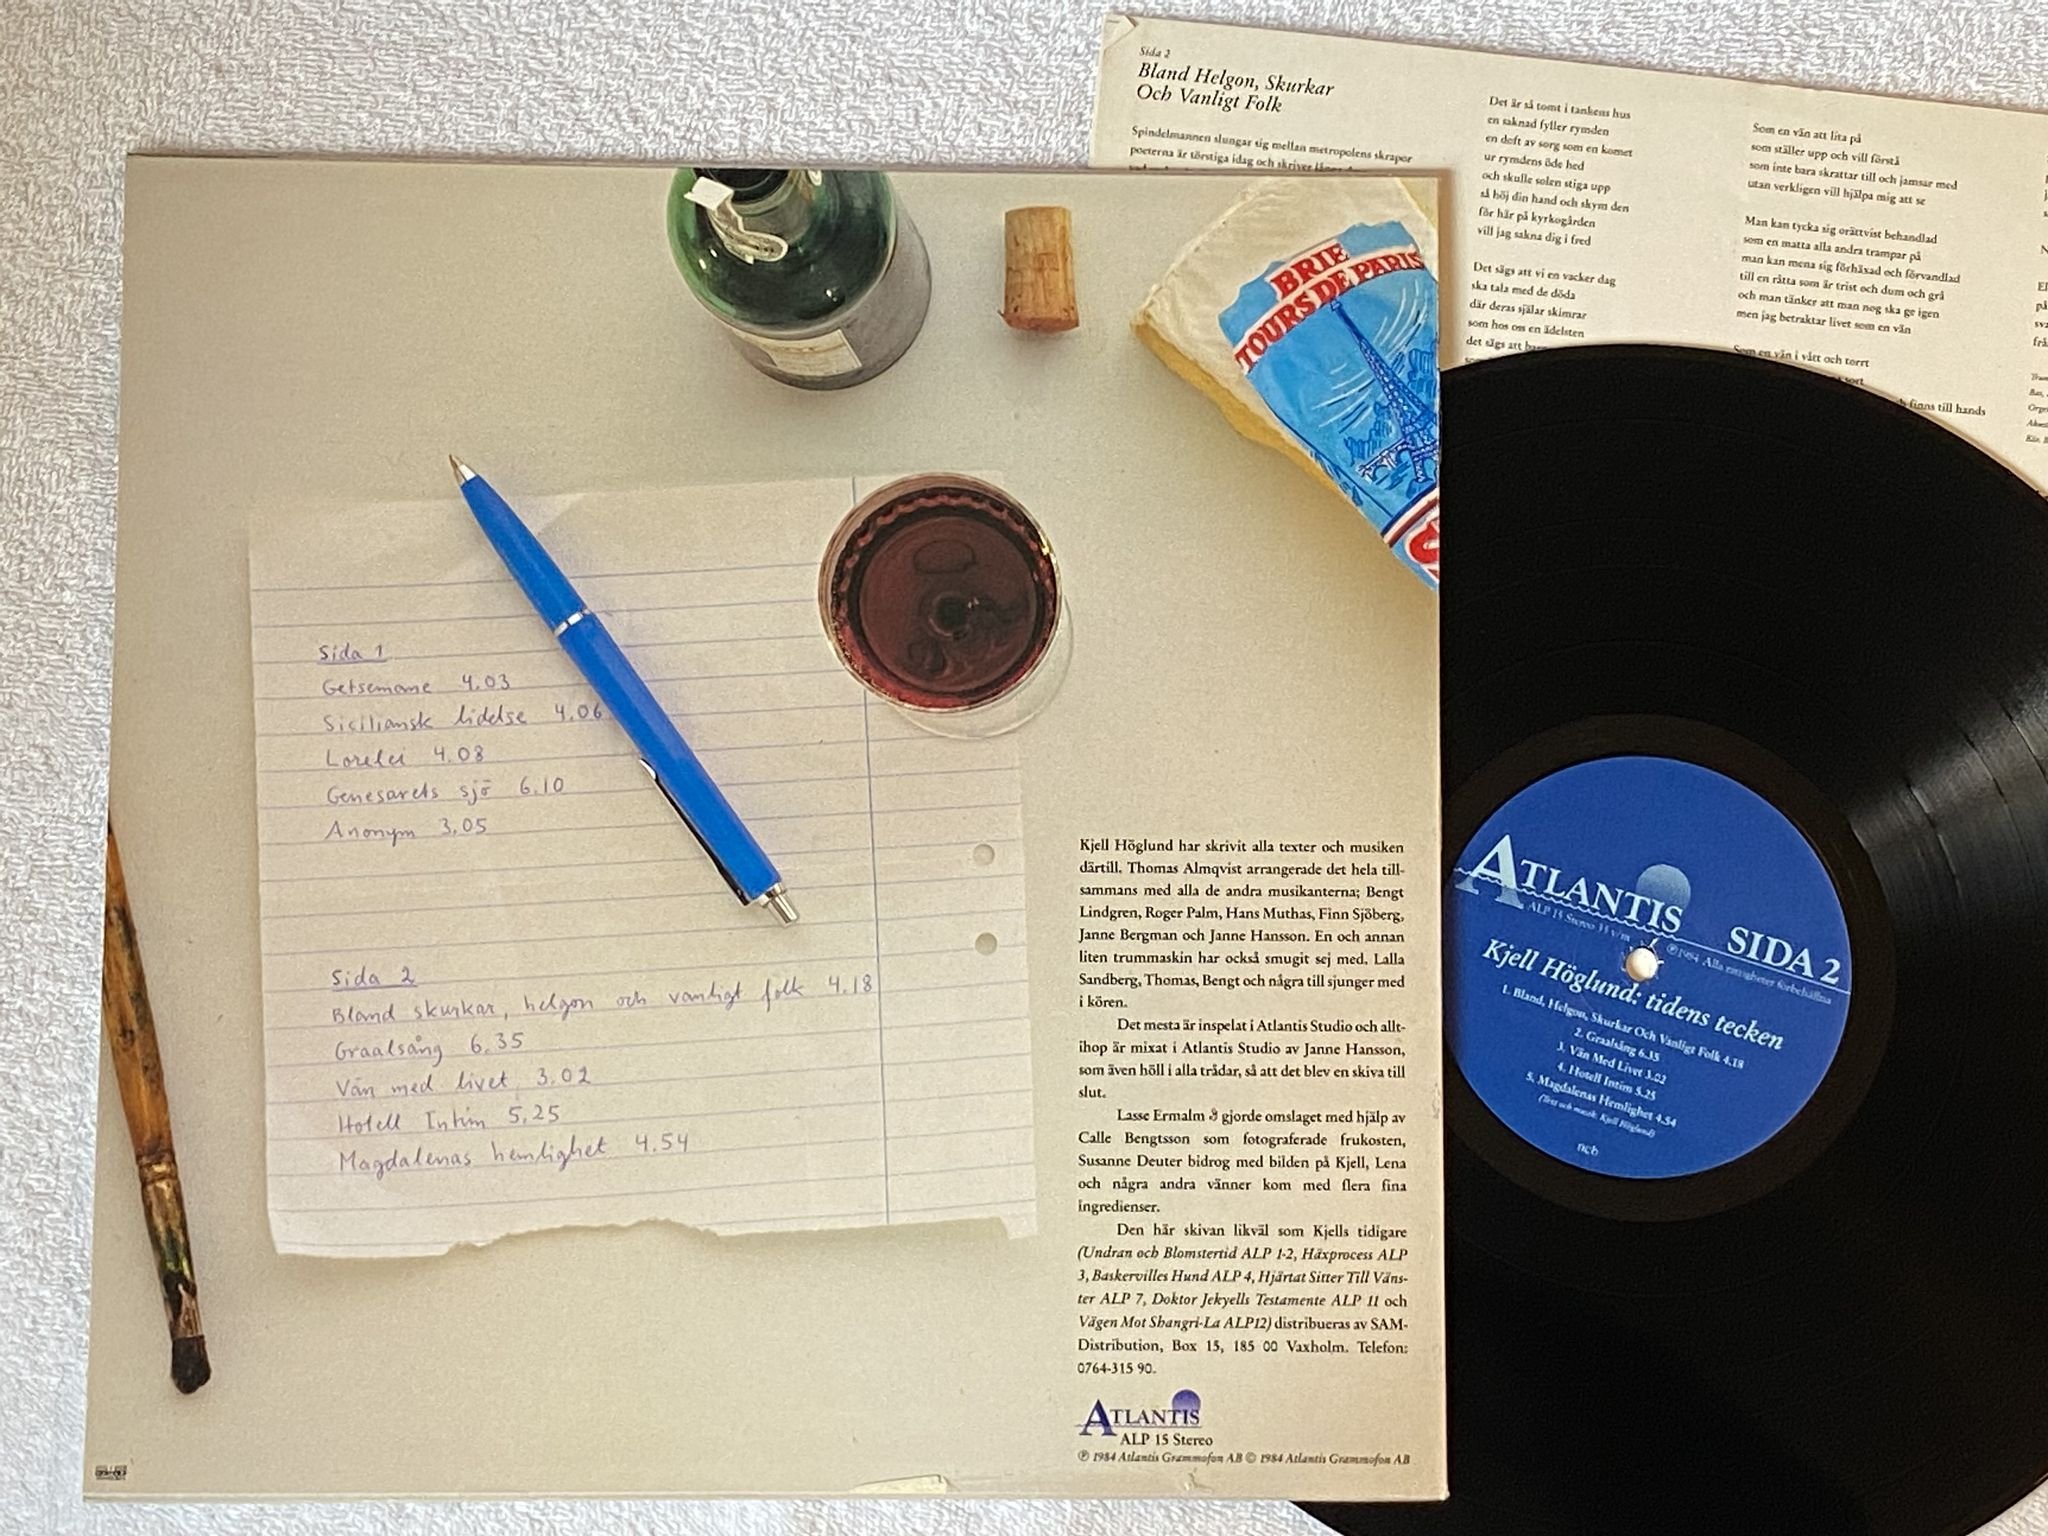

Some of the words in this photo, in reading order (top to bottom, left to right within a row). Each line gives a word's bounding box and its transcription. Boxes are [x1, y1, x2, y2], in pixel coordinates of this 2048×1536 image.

[1139, 46, 1162, 58] Sida
[1164, 49, 1171, 59] 2
[1138, 62, 1191, 82] Bland
[1194, 68, 1259, 92] Helgon,
[1265, 75, 1335, 96] Skurkar
[1137, 84, 1172, 102] Och
[1180, 88, 1240, 113] Vanligt
[1245, 94, 1282, 113] Folk
[1489, 96, 1508, 108] Det
[1510, 98, 1522, 109] är
[1524, 99, 1534, 110] så
[1536, 103, 1561, 113] tomt
[1570, 106, 1610, 118] tankens
[1612, 108, 1631, 120] hus
[1487, 117, 1500, 125] en
[1502, 116, 1538, 129] saknad
[1539, 118, 1568, 133] fyller
[1569, 124, 1610, 137] rymden
[1753, 122, 1776, 135] Som
[1778, 128, 1790, 136] en
[1792, 128, 1811, 139] vän
[1813, 132, 1827, 140] att
[1830, 130, 1847, 142] lita
[1849, 133, 1862, 146] på
[1132, 125, 1212, 143] Spindelmannen
[1214, 133, 1252, 148] slungar
[1254, 138, 1270, 152] sig
[1272, 140, 1307, 152] mellan
[1308, 146, 1372, 160] metropolens
[1374, 150, 1413, 165] skrapor
[1751, 144, 1772, 153] som
[1774, 144, 1806, 156] ställer
[1807, 150, 1828, 162] upp
[1830, 150, 1849, 161] och
[1851, 152, 1868, 163] vill
[1870, 153, 1900, 166] förstå
[1270, 243, 1350, 300] BRIE
[1235, 291, 1316, 373] TOURS
[1310, 269, 1354, 304] DE
[1350, 250, 1425, 286] PARIS
[319, 643, 362, 661] Sida
[375, 644, 384, 657] 1
[461, 673, 511, 692] 4.03
[324, 711, 433, 732] Siciliansk
[554, 702, 603, 722] 4.06
[460, 779, 492, 806] sjö
[519, 776, 565, 796] 6.10
[325, 820, 416, 847] Anonym
[1080, 838, 1109, 854] Kjell
[1115, 838, 1174, 856] Höglund
[1178, 839, 1201, 852] har
[1205, 839, 1247, 852] skrivit
[1252, 840, 1274, 852] alla
[1279, 843, 1317, 853] texter
[1322, 840, 1345, 853] och
[1350, 840, 1404, 854] musiken
[1079, 860, 1122, 874] därtill.
[1126, 861, 1179, 874] Thomas
[1183, 861, 1242, 878] Almqvist
[1246, 862, 1323, 879] arrangerade
[1326, 862, 1347, 876] det
[1351, 862, 1378, 876] hela
[1382, 863, 1404, 876] till-
[1455, 834, 1684, 933] ATLANTIS
[1727, 927, 1815, 978] SIDA
[1820, 959, 1841, 986] 2
[331, 966, 381, 986] Sida
[400, 967, 416, 986] 2
[332, 1004, 395, 1023] Bland
[414, 999, 509, 1021] skurkar,
[523, 993, 595, 1021] helgon
[616, 991, 647, 1008] och
[668, 981, 742, 1010] vanligt
[761, 976, 804, 1012] folk
[827, 973, 874, 995] 4.18
[1079, 995, 1084, 1008] i
[1087, 994, 1128, 1008] kören.
[1482, 939, 1540, 971] Kjell
[1540, 957, 1642, 1005] Höglund:
[1645, 993, 1711, 1026] tidens
[1714, 1016, 1784, 1050] tecken
[1513, 987, 1546, 1008] Bland,
[1548, 998, 1589, 1022] Helgon,
[1590, 1012, 1633, 1034] Skurkar
[1634, 1026, 1656, 1042] Och
[1660, 1033, 1696, 1055] Vanligt
[1697, 1046, 1721, 1062] Folk
[1723, 1056, 1744, 1069] 4.18
[334, 1035, 444, 1067] Graalsång
[1574, 1027, 1584, 1038] 2.
[1586, 1031, 1637, 1058] Graalsång
[1570, 1044, 1590, 1061] Vän
[1592, 1052, 1616, 1069] Med
[1617, 1060, 1644, 1078] Livet
[335, 1076, 376, 1098] Vän
[391, 1074, 434, 1093] med
[456, 1071, 510, 1091] livet
[1078, 1085, 1106, 1098] slut.
[1557, 1062, 1566, 1073] 4.
[1568, 1064, 1603, 1084] Hotell
[1603, 1076, 1633, 1094] Intim
[1634, 1086, 1656, 1101] 5.25
[1526, 1071, 1535, 1083] 5.
[1537, 1074, 1596, 1102] Magdalenas
[1598, 1094, 1654, 1121] Hemlighet
[1655, 1114, 1677, 1128] 4.54
[337, 1114, 401, 1133] Hotell
[426, 1108, 486, 1131] Intim
[338, 1147, 473, 1180] Magdalenas
[490, 1134, 608, 1171] hemlighet
[635, 1132, 689, 1153] 4.54
[1078, 1338, 1164, 1353] Distribution,
[1172, 1339, 1197, 1352] Box
[1207, 1340, 1224, 1354] 15,
[1234, 1340, 1255, 1352] 185
[1263, 1340, 1278, 1353] 00
[1286, 1339, 1349, 1353] Vaxholm.
[1356, 1340, 1408, 1354] Telefon:
[1077, 1362, 1134, 1374] 0764-315
[1137, 1362, 1156, 1374] 90.
[1079, 1399, 1200, 1437] ATLANTIS
[1120, 1432, 1150, 1446] ALP
[1156, 1433, 1169, 1446] 15
[1173, 1433, 1214, 1446] Stereo
[1093, 1452, 1117, 1462] 1984
[1118, 1450, 1160, 1462] Atlantis
[1161, 1451, 1224, 1466] Grammofon
[1226, 1452, 1243, 1464] AB
[1260, 1453, 1284, 1464] 1984
[1285, 1452, 1327, 1464] Atlantis
[1329, 1453, 1391, 1467] Grammofon
[1393, 1454, 1410, 1465] AB
